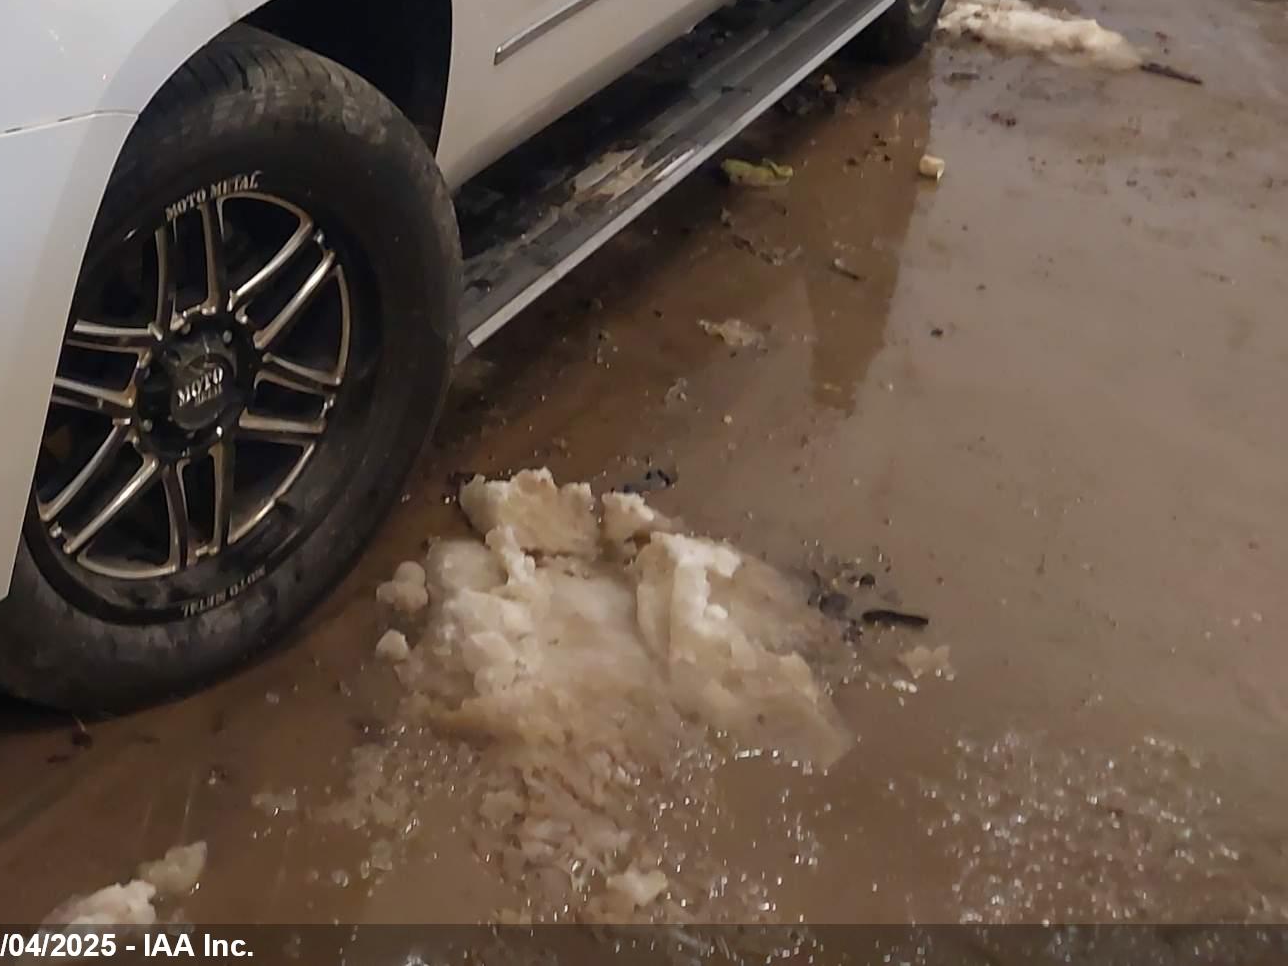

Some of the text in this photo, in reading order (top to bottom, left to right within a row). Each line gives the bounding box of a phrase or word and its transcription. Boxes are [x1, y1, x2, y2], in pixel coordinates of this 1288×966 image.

[165, 170, 264, 222] MOTO METAL
[177, 365, 224, 407] MOTO
